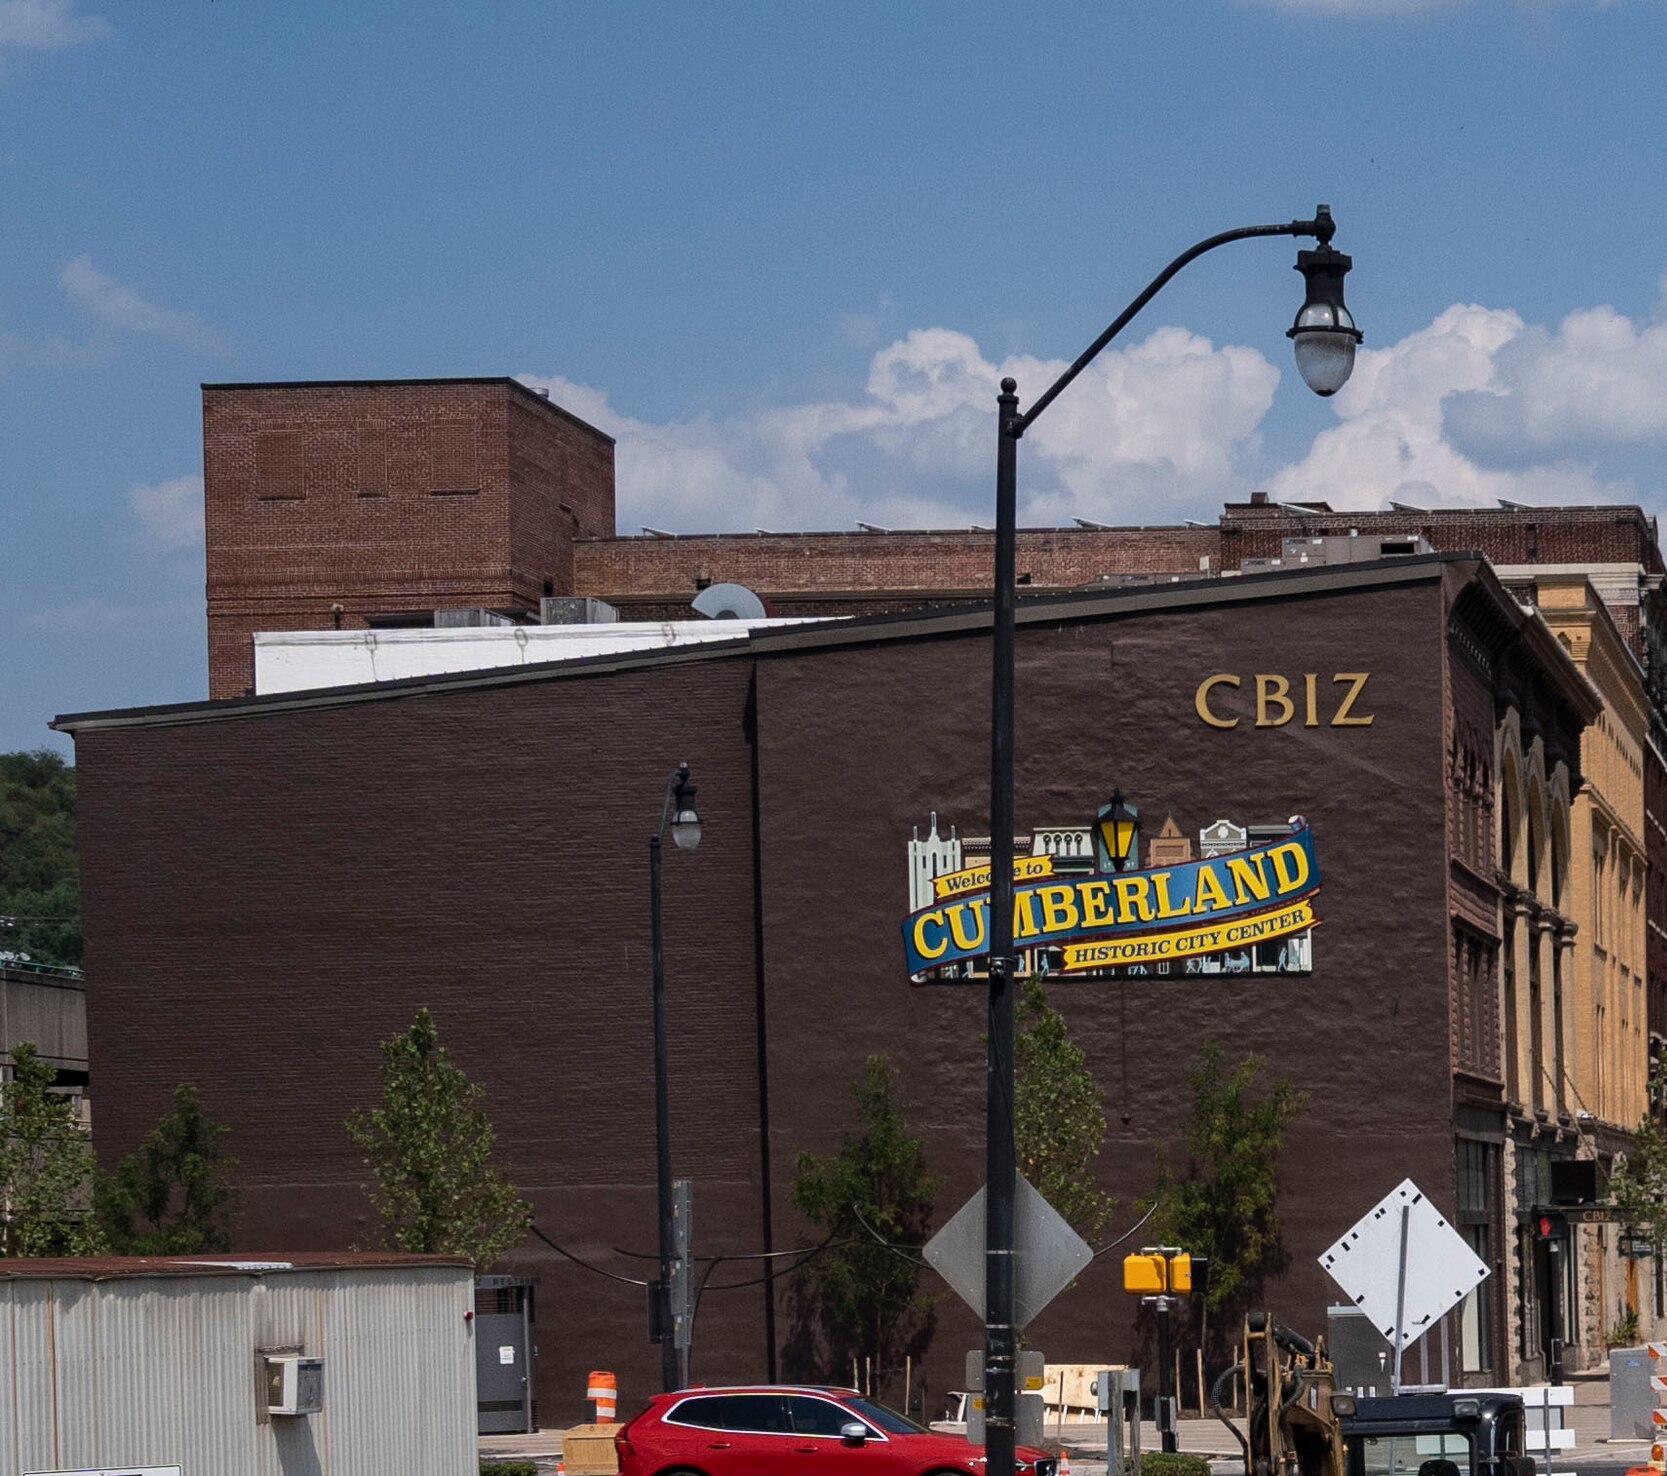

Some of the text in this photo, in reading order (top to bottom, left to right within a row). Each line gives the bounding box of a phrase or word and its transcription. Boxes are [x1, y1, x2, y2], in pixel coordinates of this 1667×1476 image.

[1195, 672, 1375, 728] CBIZ
[946, 860, 1044, 890] Welcoe to
[1074, 909, 1307, 963] HISTORIC CITY CENTER
